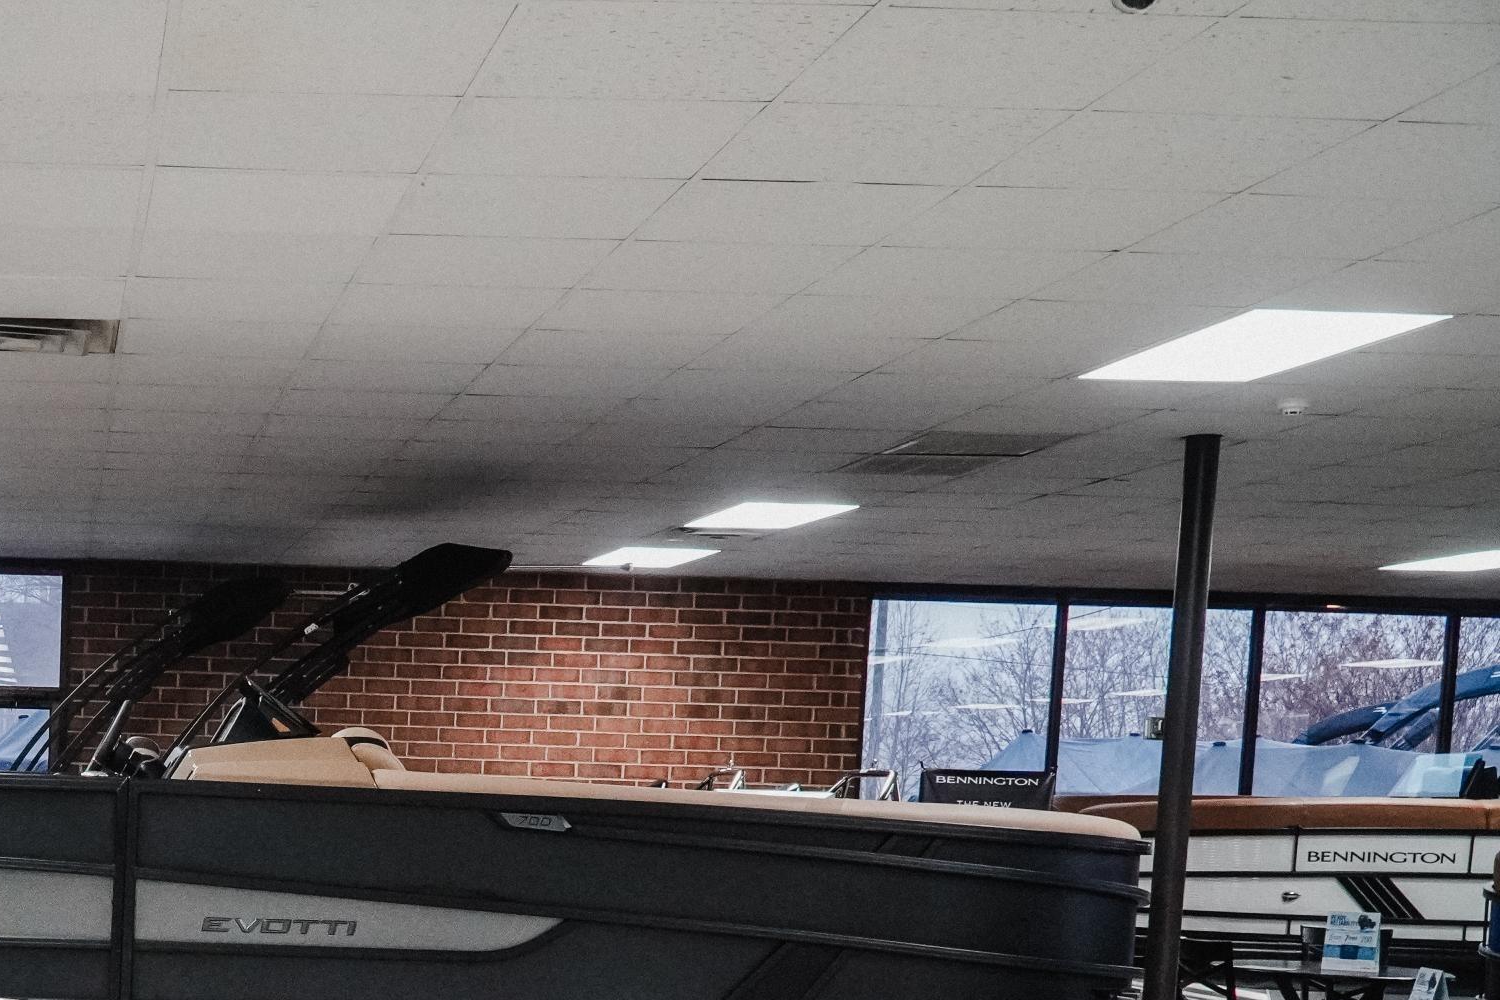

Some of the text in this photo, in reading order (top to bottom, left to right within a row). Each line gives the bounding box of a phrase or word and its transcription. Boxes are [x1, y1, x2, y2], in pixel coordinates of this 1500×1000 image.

[935, 775, 1039, 786] BENNINGTON
[519, 815, 553, 827] 700
[1307, 850, 1456, 865] BENNINGTON
[201, 916, 358, 936] EVOTTI
